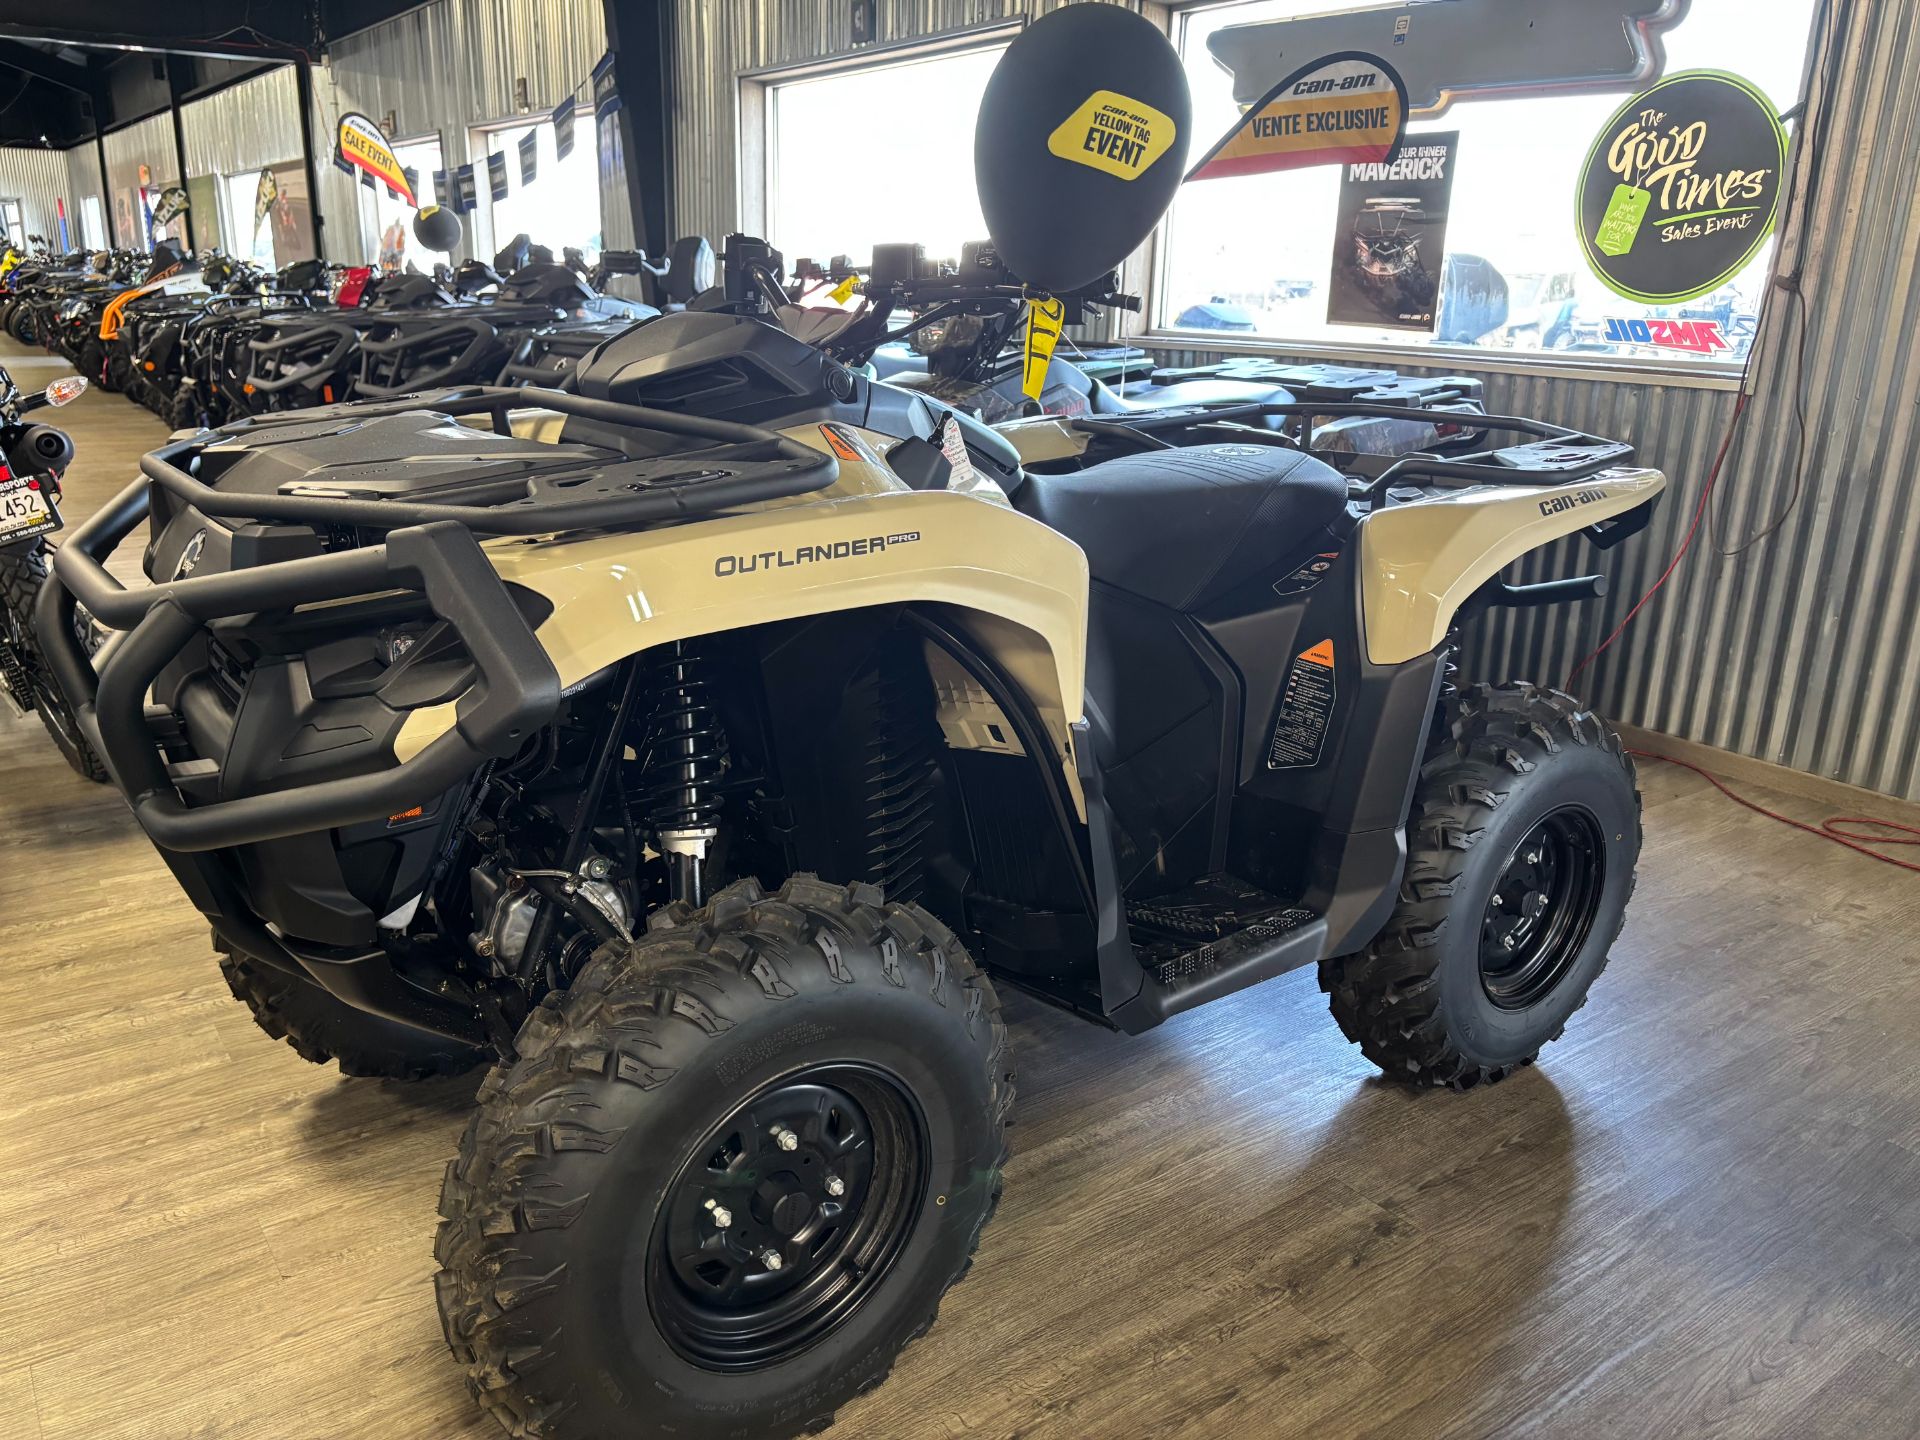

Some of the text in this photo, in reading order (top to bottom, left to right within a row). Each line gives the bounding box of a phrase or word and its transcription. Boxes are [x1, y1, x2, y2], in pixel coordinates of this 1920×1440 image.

[1293, 73, 1376, 96] can-am
[1093, 111, 1151, 144] YELLOW TAG
[1102, 104, 1148, 125] can-am
[1252, 107, 1389, 138] VENTE EXCLUSIVE
[1640, 108, 1667, 127] The
[344, 131, 393, 171] SALE EVENT
[1083, 126, 1146, 168] EVENT
[1349, 157, 1446, 182] MAVERICK
[1661, 213, 1753, 243] Sales Event
[1539, 490, 1608, 517] can-am
[715, 532, 918, 577] OUTLANDER PRO
